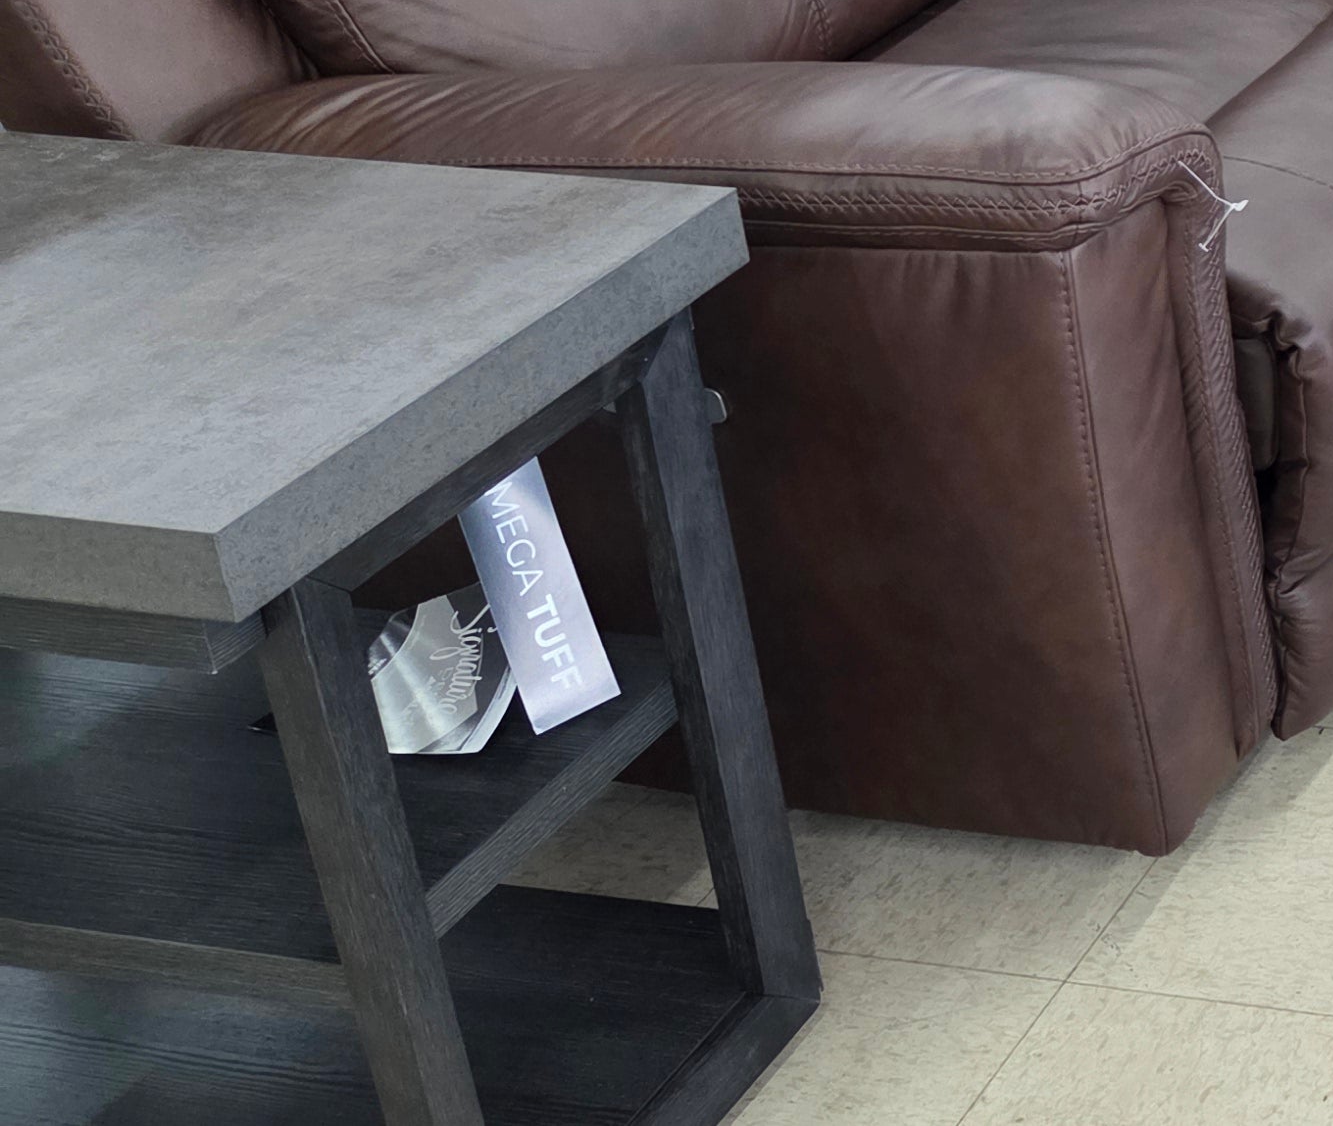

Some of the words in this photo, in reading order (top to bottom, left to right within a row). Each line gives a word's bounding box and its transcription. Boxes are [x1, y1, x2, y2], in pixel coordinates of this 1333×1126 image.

[430, 602, 498, 716] Signature
[485, 481, 545, 596] MEGA
[526, 593, 583, 690] TUFF
